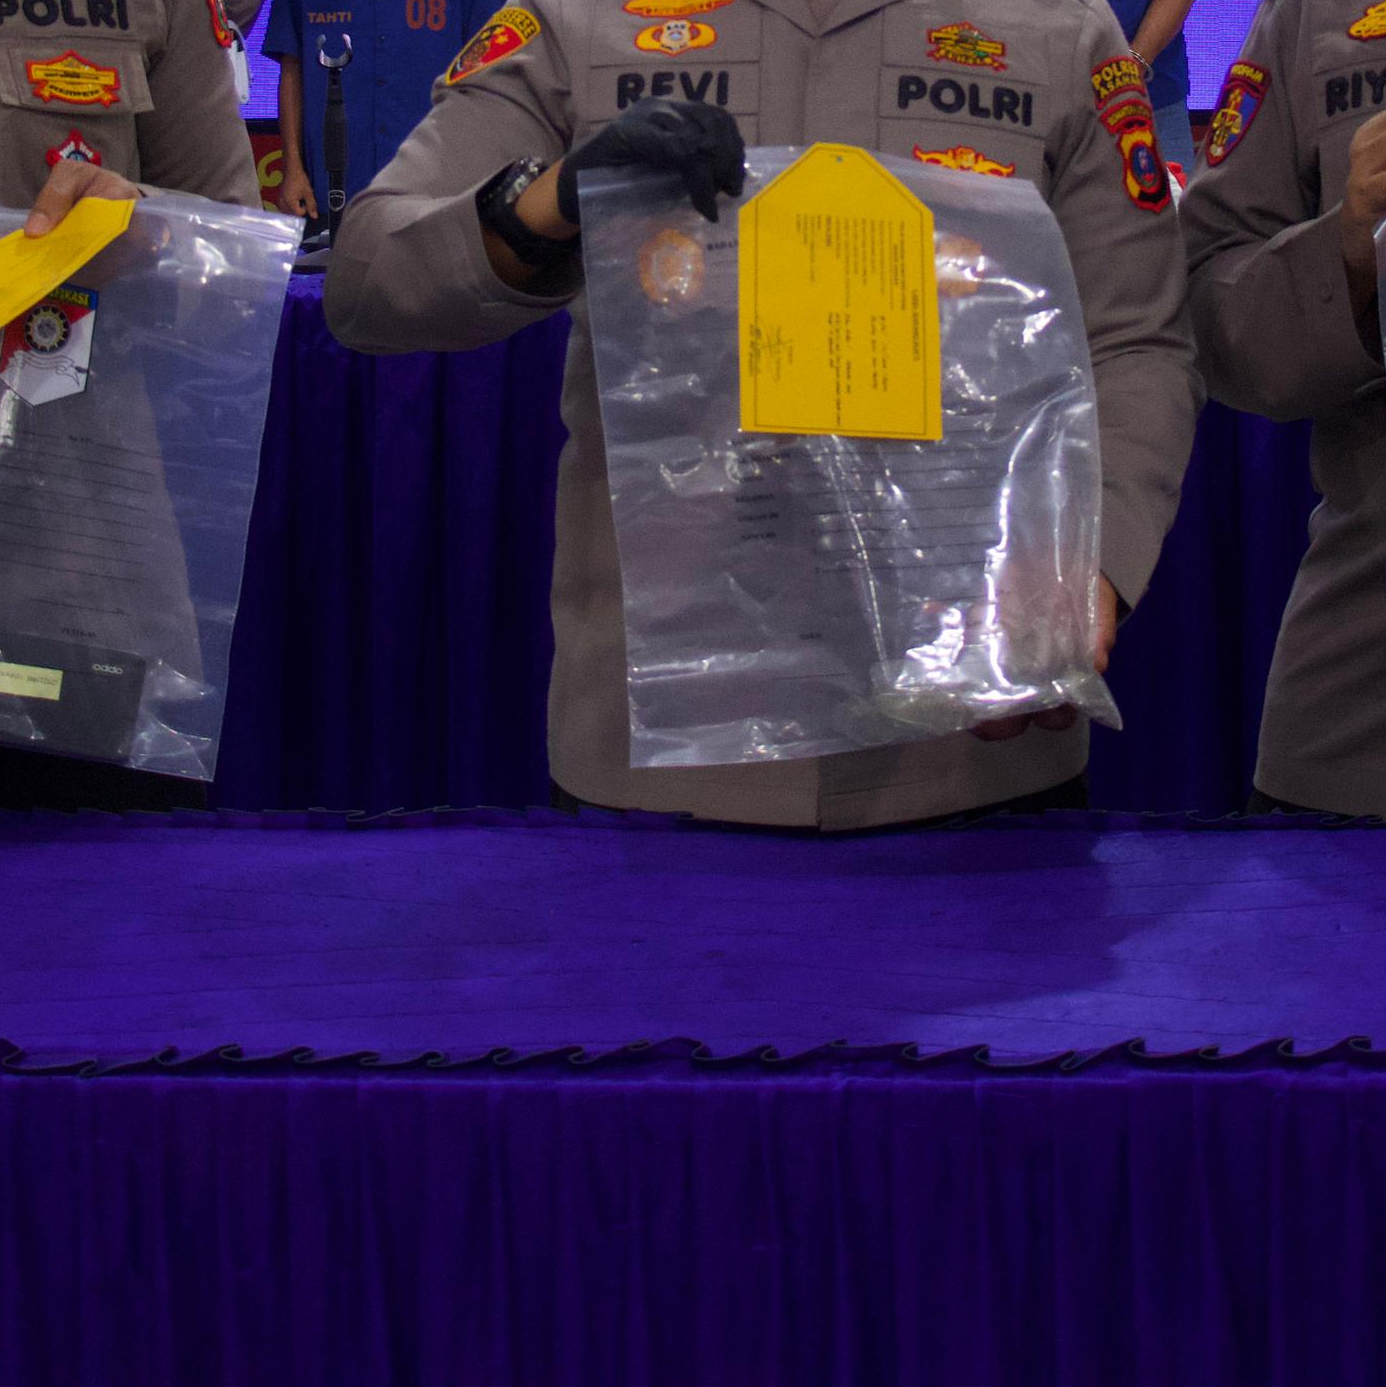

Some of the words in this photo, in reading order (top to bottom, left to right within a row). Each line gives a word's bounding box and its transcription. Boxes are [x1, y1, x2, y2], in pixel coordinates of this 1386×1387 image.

[307, 11, 353, 24] TAHTI
[617, 70, 730, 111] REVI
[898, 74, 1033, 127] POLRI
[92, 663, 124, 675] oppo
